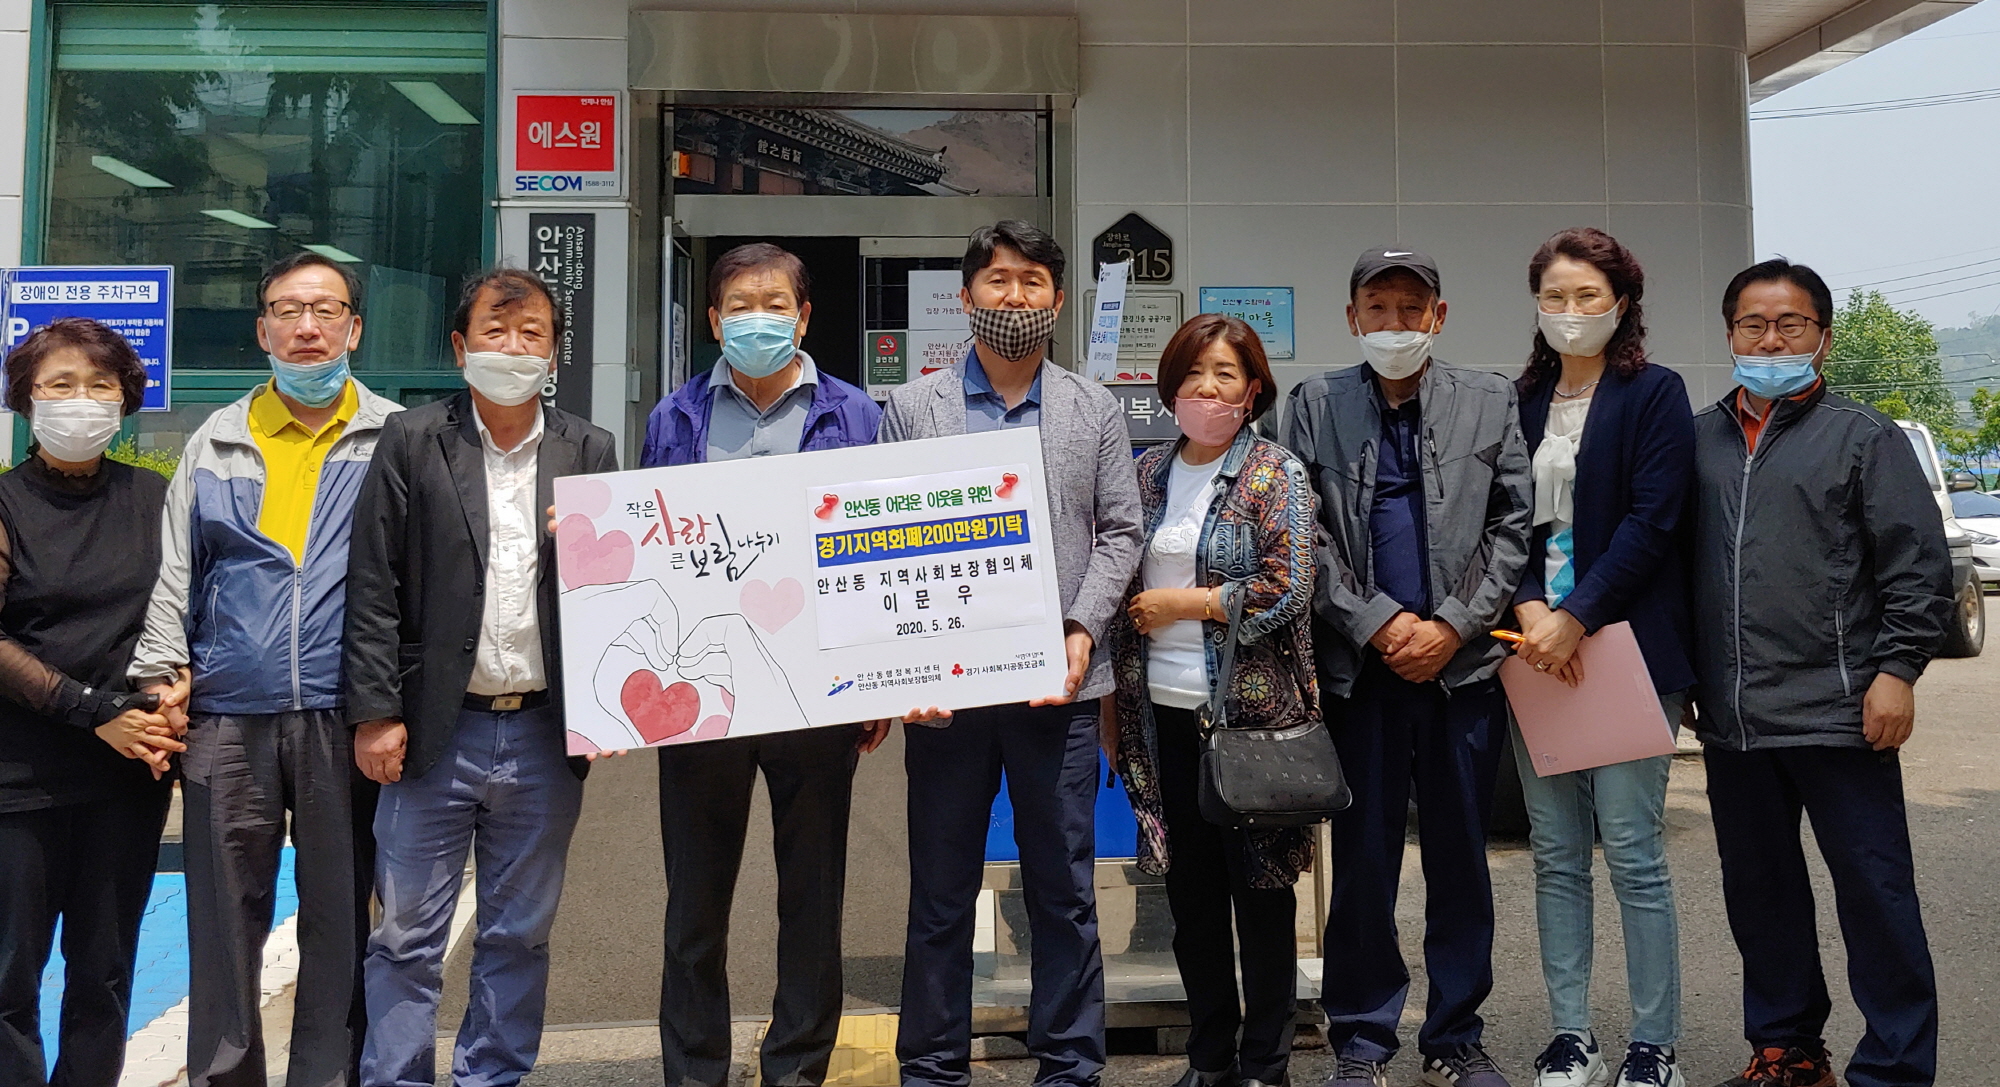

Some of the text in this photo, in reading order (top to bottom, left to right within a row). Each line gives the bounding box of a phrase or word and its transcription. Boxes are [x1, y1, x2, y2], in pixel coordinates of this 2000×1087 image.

[528, 121, 601, 149] 에스원
[515, 175, 582, 191] SECOM
[574, 226, 585, 290] Ansan-dong
[20, 284, 151, 301] 장애인 전용 주차구역
[563, 227, 575, 366] Community Service Center
[926, 307, 964, 315] 입장 가능합
[8, 318, 29, 346] P
[626, 489, 712, 546] 작은 사랑
[844, 485, 993, 519] 안산동 어려운 이웃을 위한
[670, 552, 685, 570] 큰
[737, 531, 780, 553] 나누기
[818, 514, 1023, 559] 경기지역화폐200만원기탁
[817, 553, 1033, 595] 안산동 지역사회보장협의체
[858, 673, 942, 691] 안산동 지역사회보장협의체
[966, 659, 1045, 676] 경기 사회복지공동모금회
